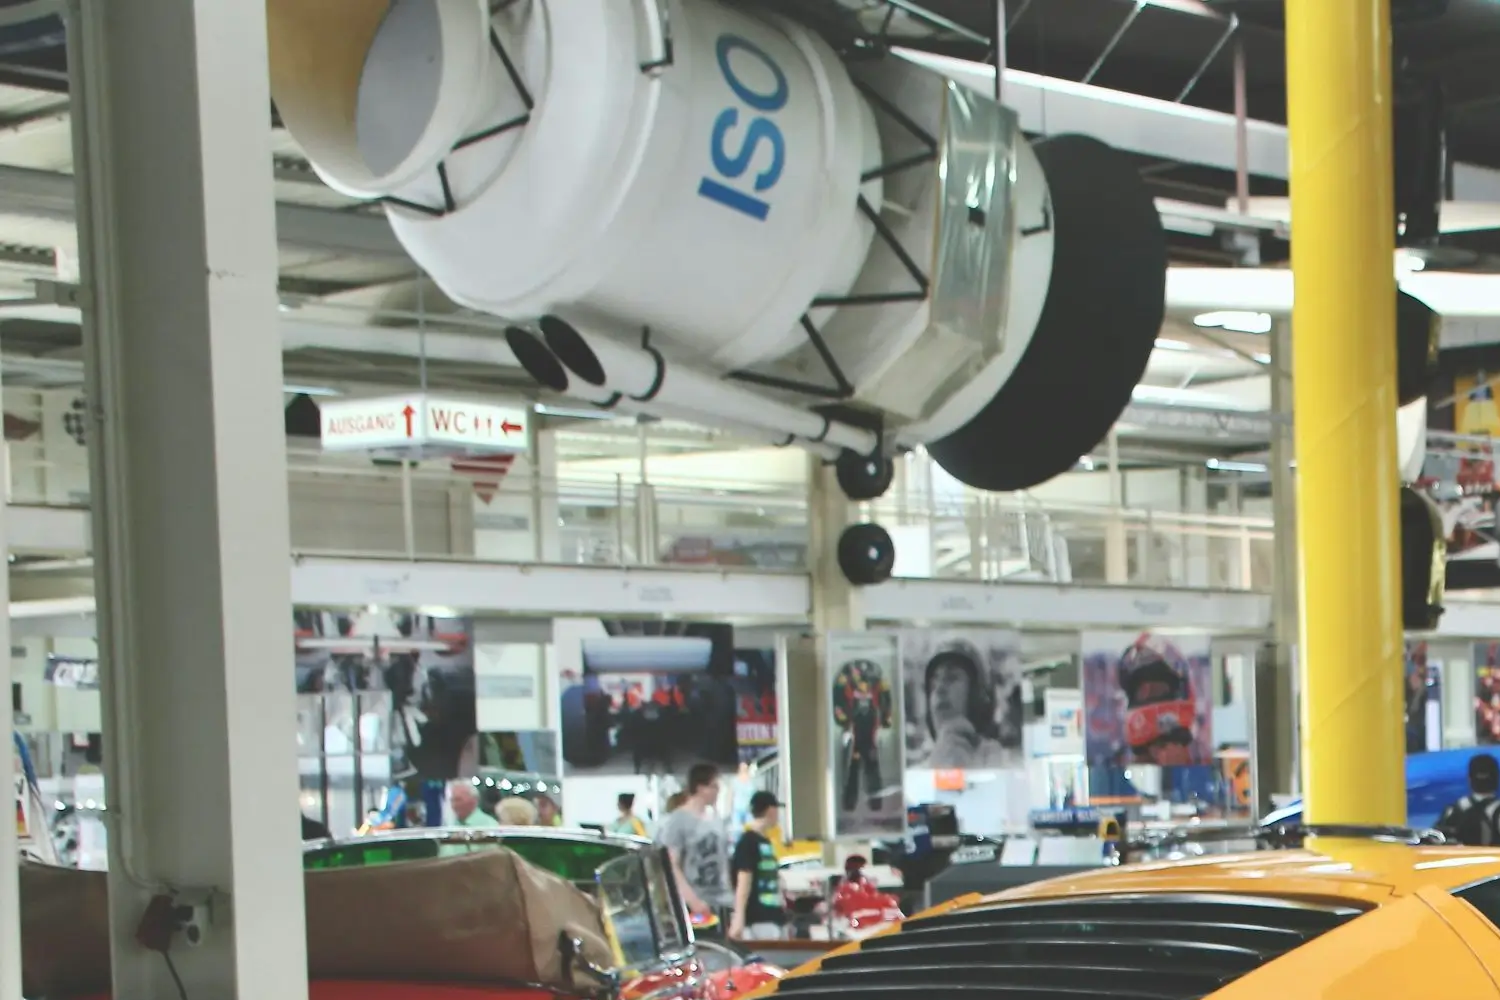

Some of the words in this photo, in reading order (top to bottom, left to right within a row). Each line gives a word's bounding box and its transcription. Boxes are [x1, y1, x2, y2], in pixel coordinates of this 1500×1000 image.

[698, 32, 789, 221] ISO
[328, 413, 396, 435] AUSGANG
[431, 407, 467, 435] WC
